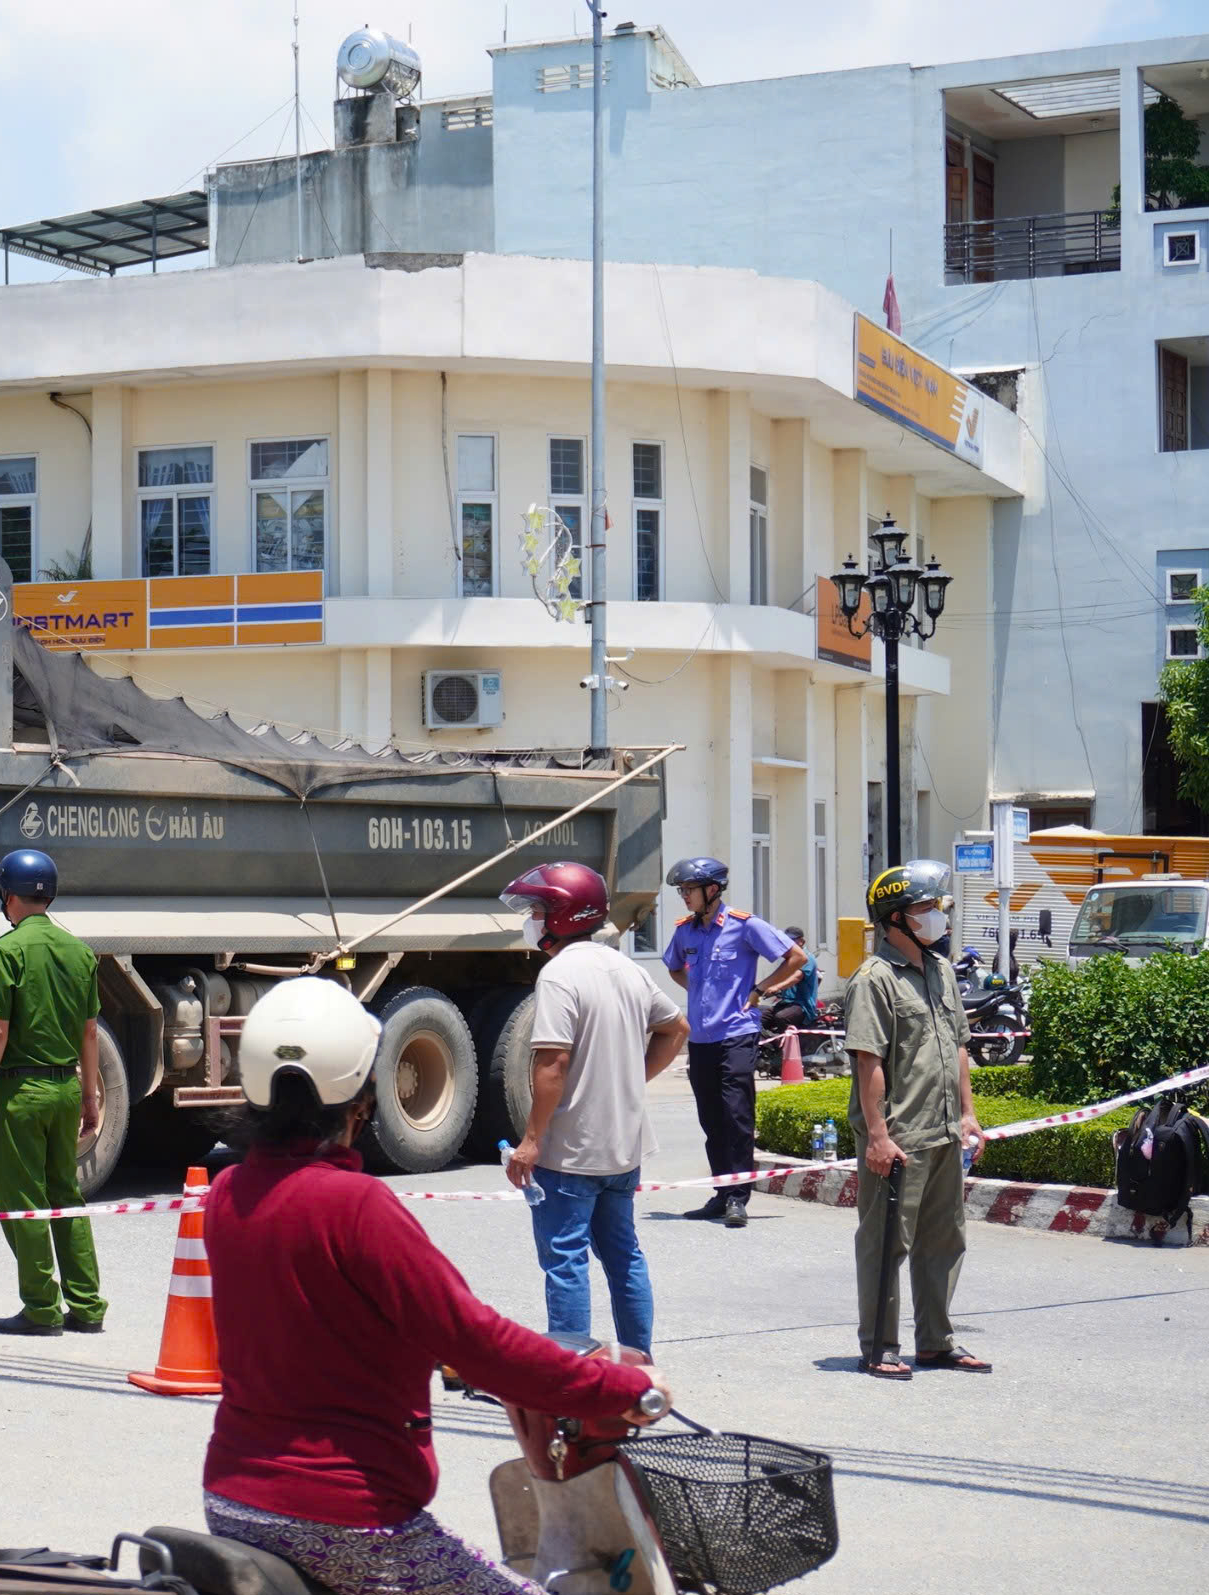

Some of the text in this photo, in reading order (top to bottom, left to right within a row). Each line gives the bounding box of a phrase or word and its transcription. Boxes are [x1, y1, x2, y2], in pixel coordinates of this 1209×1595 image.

[47, 805, 224, 839] CHENGLONG HẢI ÂU
[368, 817, 471, 850] 60H-103.15
[876, 880, 910, 898] BVDP
